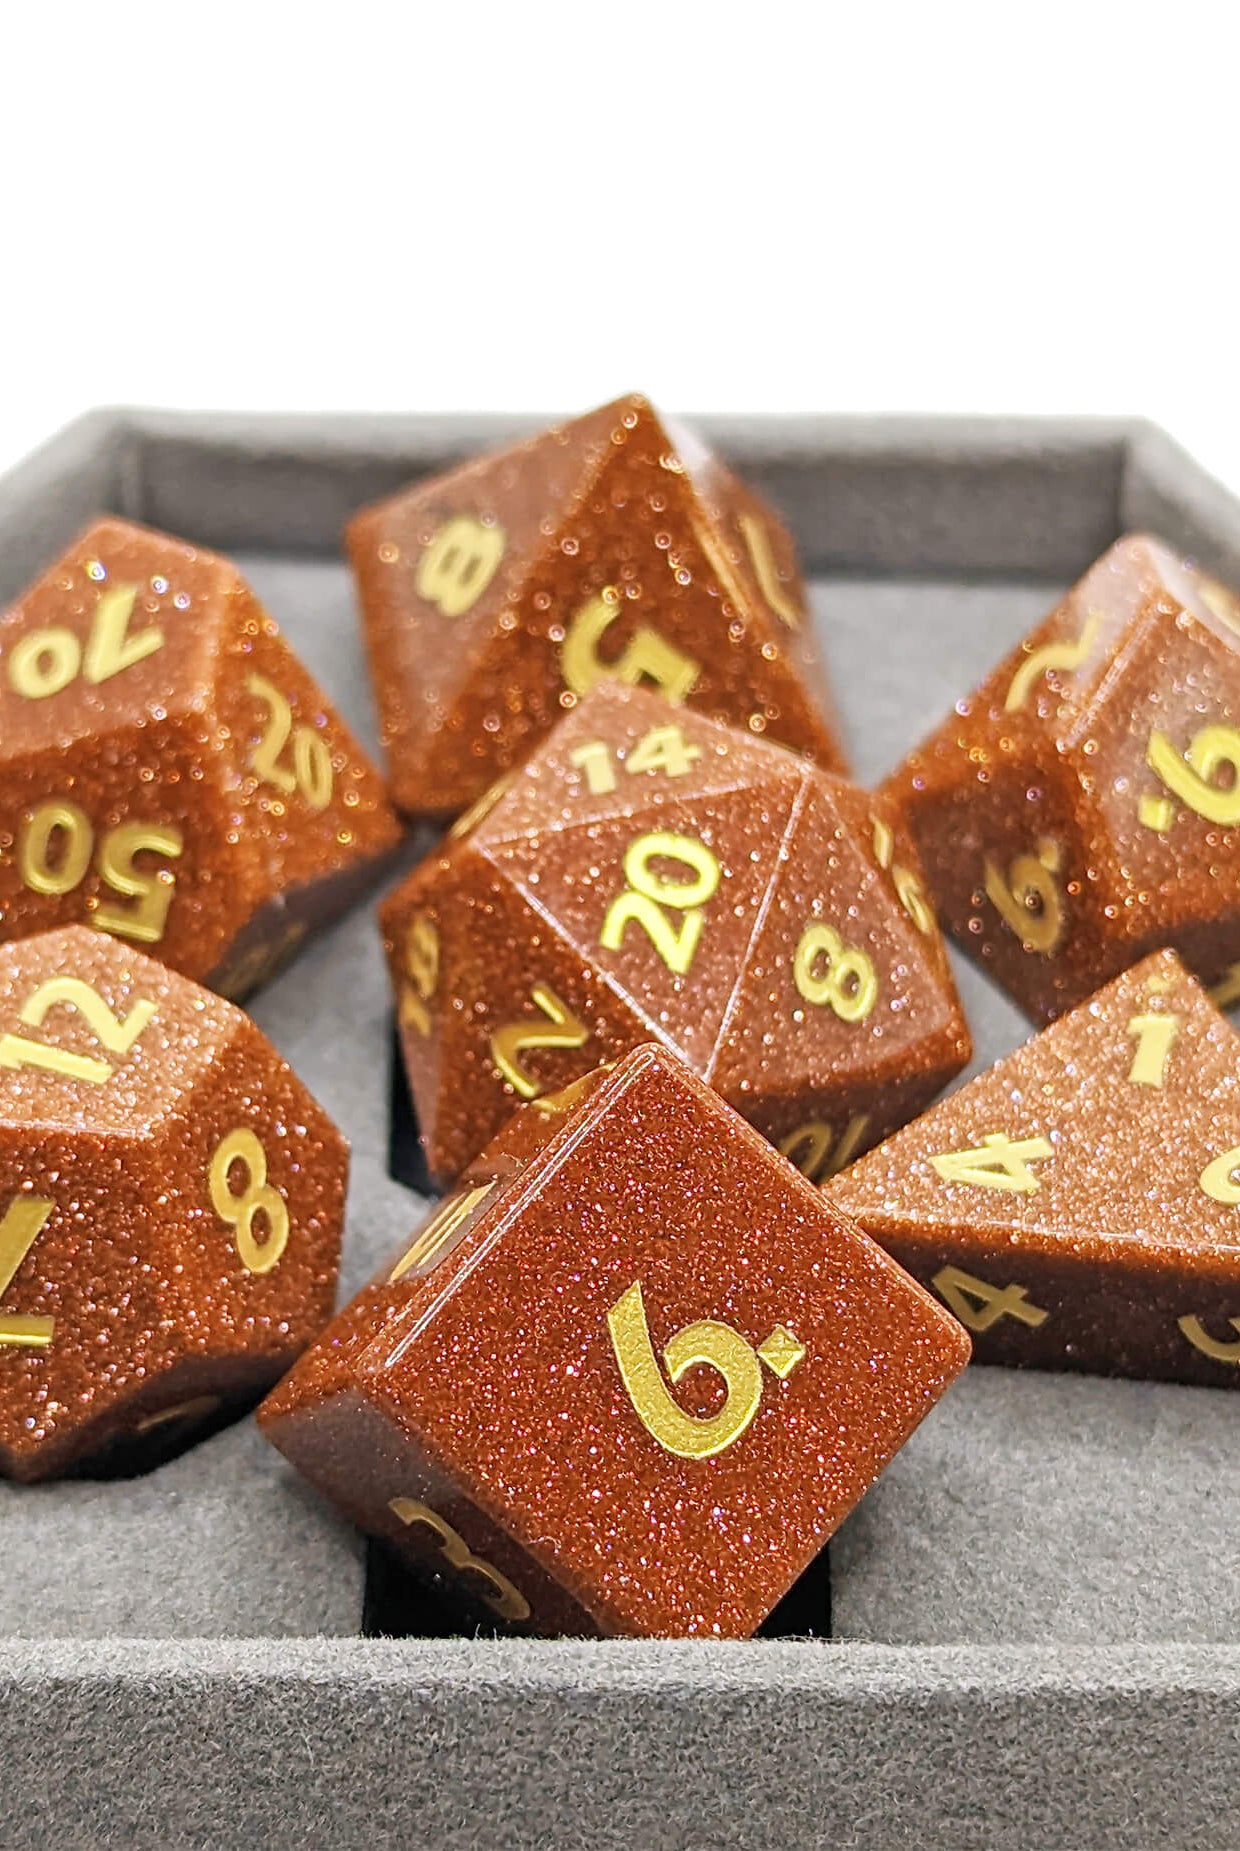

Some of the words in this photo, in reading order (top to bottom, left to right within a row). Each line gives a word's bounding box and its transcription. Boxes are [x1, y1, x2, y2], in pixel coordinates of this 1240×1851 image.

[246, 672, 333, 808] 20
[571, 725, 700, 794] 14
[600, 831, 720, 975] 20
[793, 922, 878, 1024] 8
[0, 976, 157, 1086] 12
[491, 985, 588, 1098] 2
[1126, 1013, 1179, 1089] 1
[208, 1127, 290, 1274] 8
[929, 1131, 1055, 1194] 4
[930, 1264, 1050, 1332] 4
[387, 1496, 532, 1622] 3
